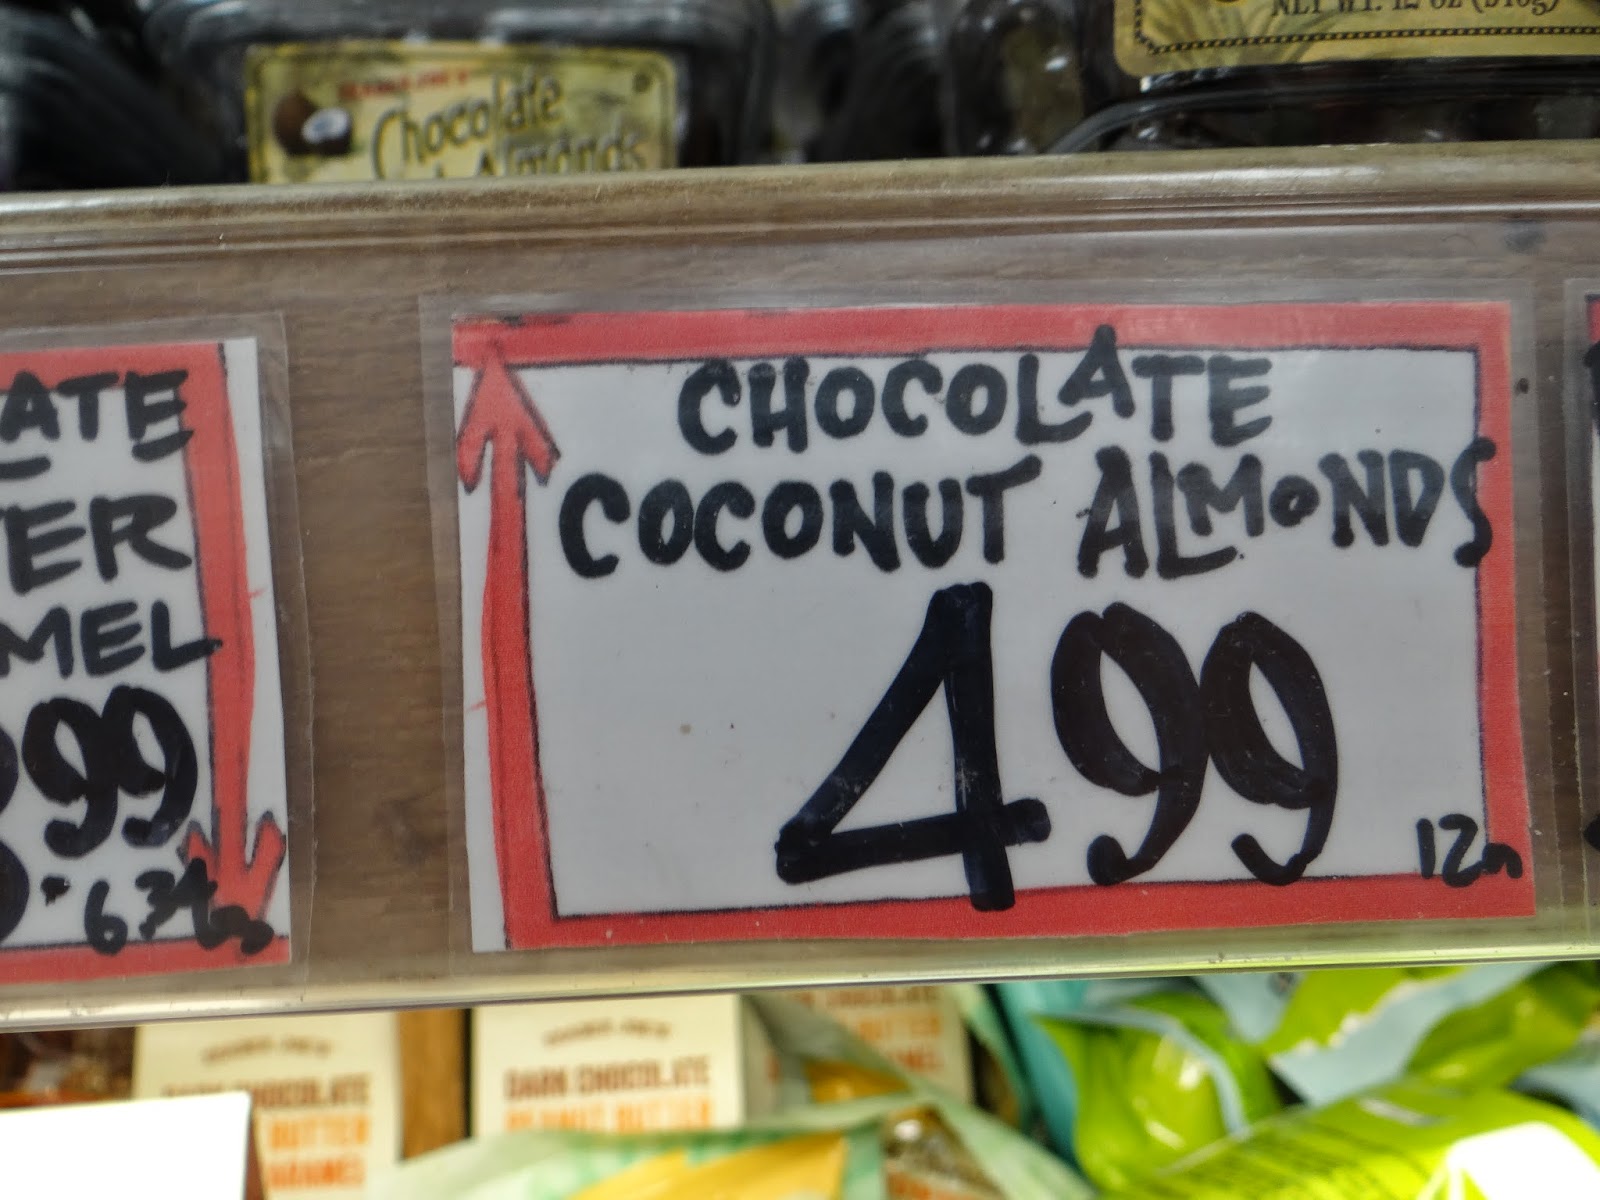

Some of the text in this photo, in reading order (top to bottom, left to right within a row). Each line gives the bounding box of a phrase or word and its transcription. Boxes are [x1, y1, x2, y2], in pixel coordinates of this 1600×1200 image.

[370, 70, 563, 180] Chocolate
[677, 325, 1274, 456] CHOCOLATE
[558, 435, 1498, 580] COCONUT ALMONDS
